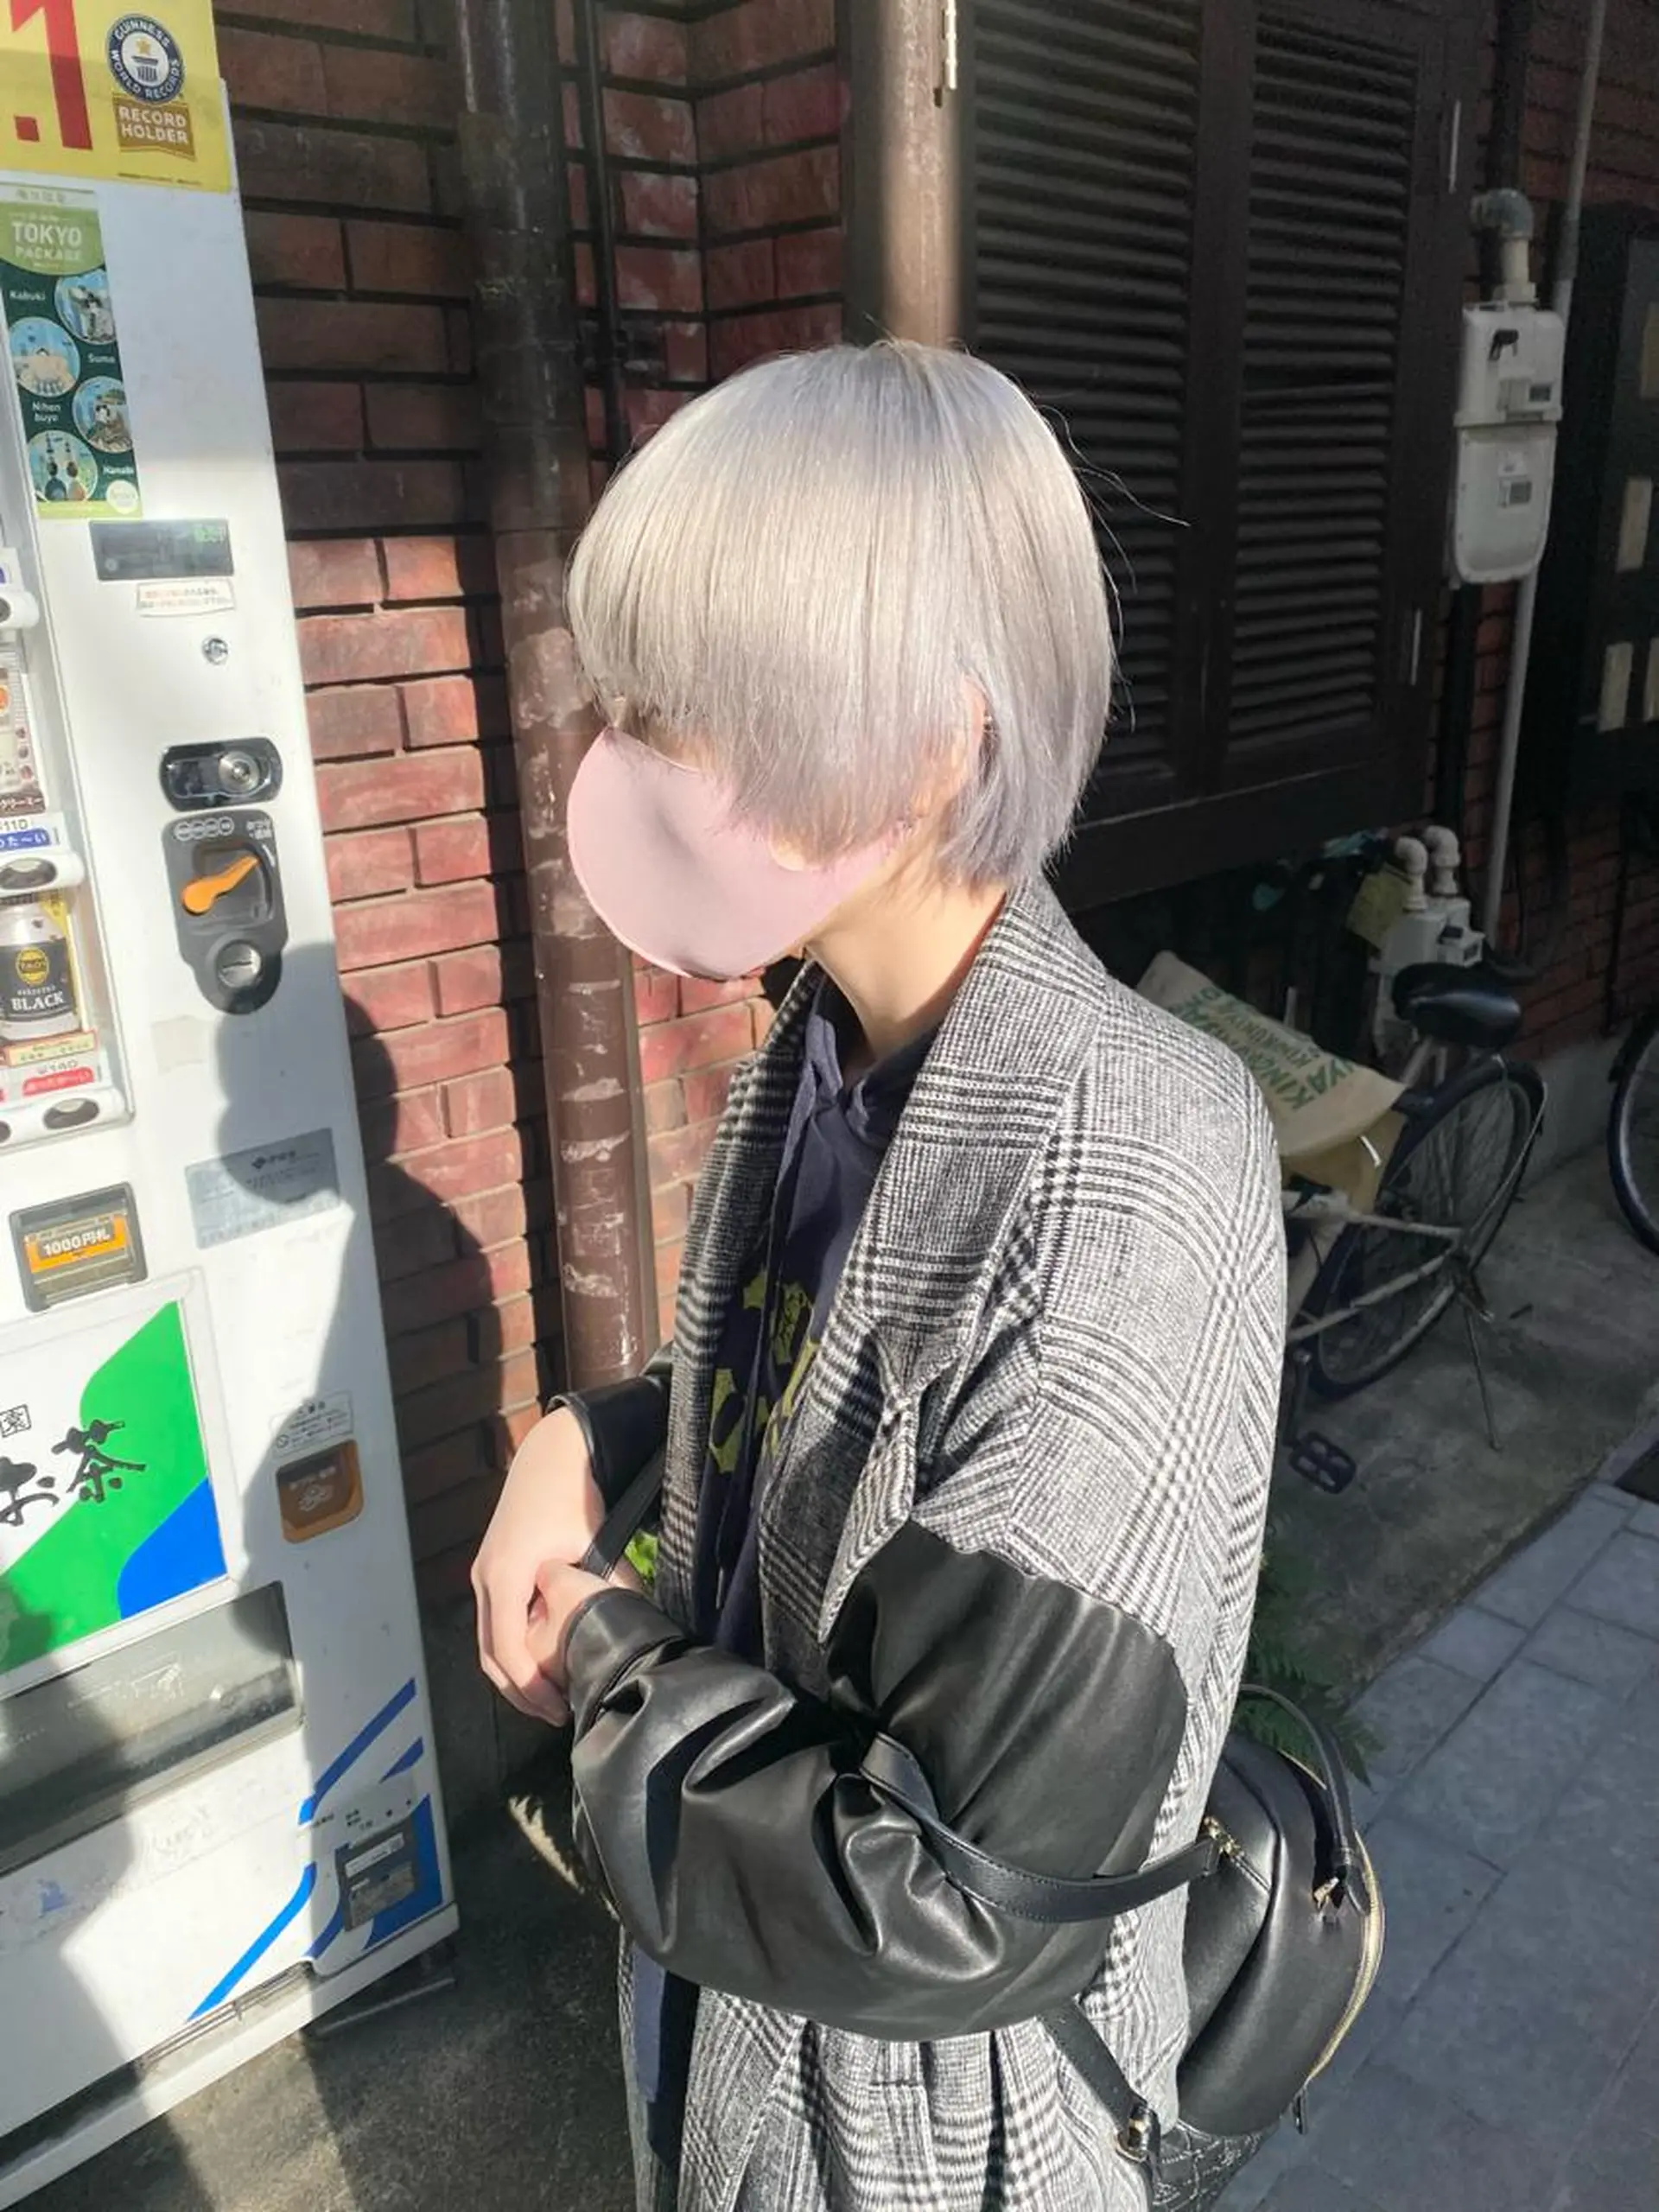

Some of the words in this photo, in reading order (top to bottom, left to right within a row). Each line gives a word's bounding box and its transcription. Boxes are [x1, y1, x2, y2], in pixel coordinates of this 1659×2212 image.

[114, 20, 170, 47] GUINNESS
[111, 49, 142, 94] WORLD
[118, 105, 187, 126] RECORD
[121, 124, 188, 143] HOLDER
[11, 222, 82, 246] TOKYO
[10, 990, 65, 1011] BLACK
[43, 1226, 111, 1256] 1000円札
